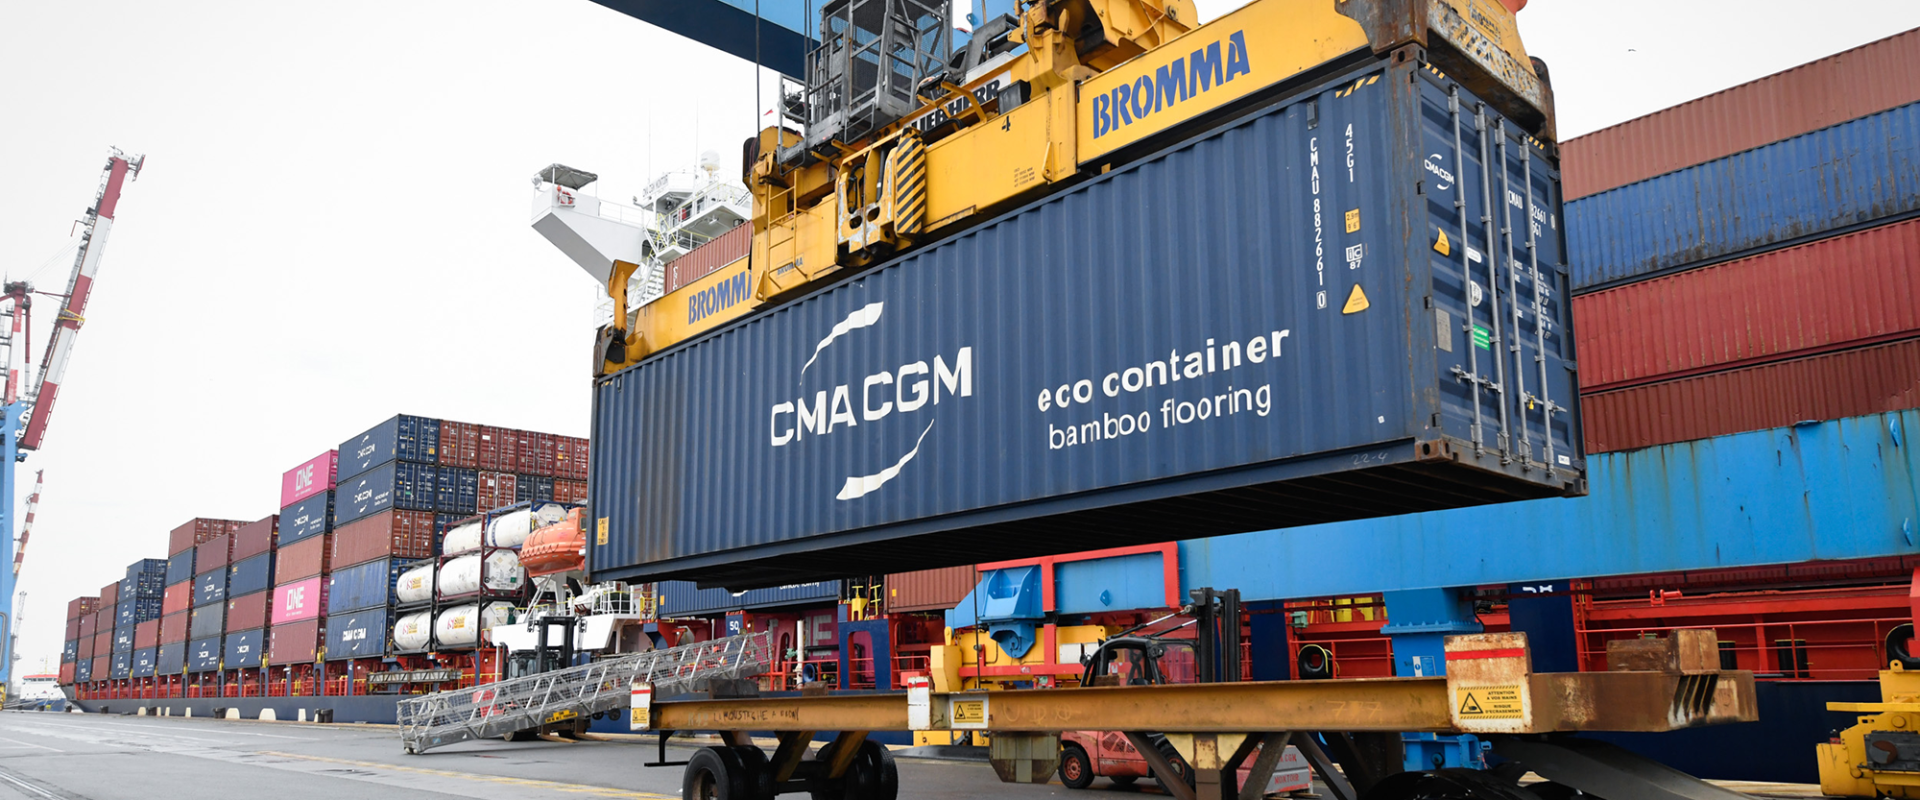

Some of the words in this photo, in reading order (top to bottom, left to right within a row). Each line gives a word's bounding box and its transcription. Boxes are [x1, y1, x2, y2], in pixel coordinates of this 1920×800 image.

[1093, 29, 1251, 140] BROMMA
[1001, 116, 1011, 132] 4
[1345, 123, 1354, 183] 45G1
[1310, 137, 1319, 194] CMAU
[1313, 198, 1323, 286] 882661
[1349, 260, 1361, 270] 87
[1317, 291, 1326, 309] 0
[771, 385, 858, 447] CMA
[863, 346, 973, 422] CGM
[1037, 379, 1093, 412] eco
[1102, 329, 1290, 397] container
[1049, 411, 1151, 450] bamboo
[1160, 384, 1271, 428] flooring
